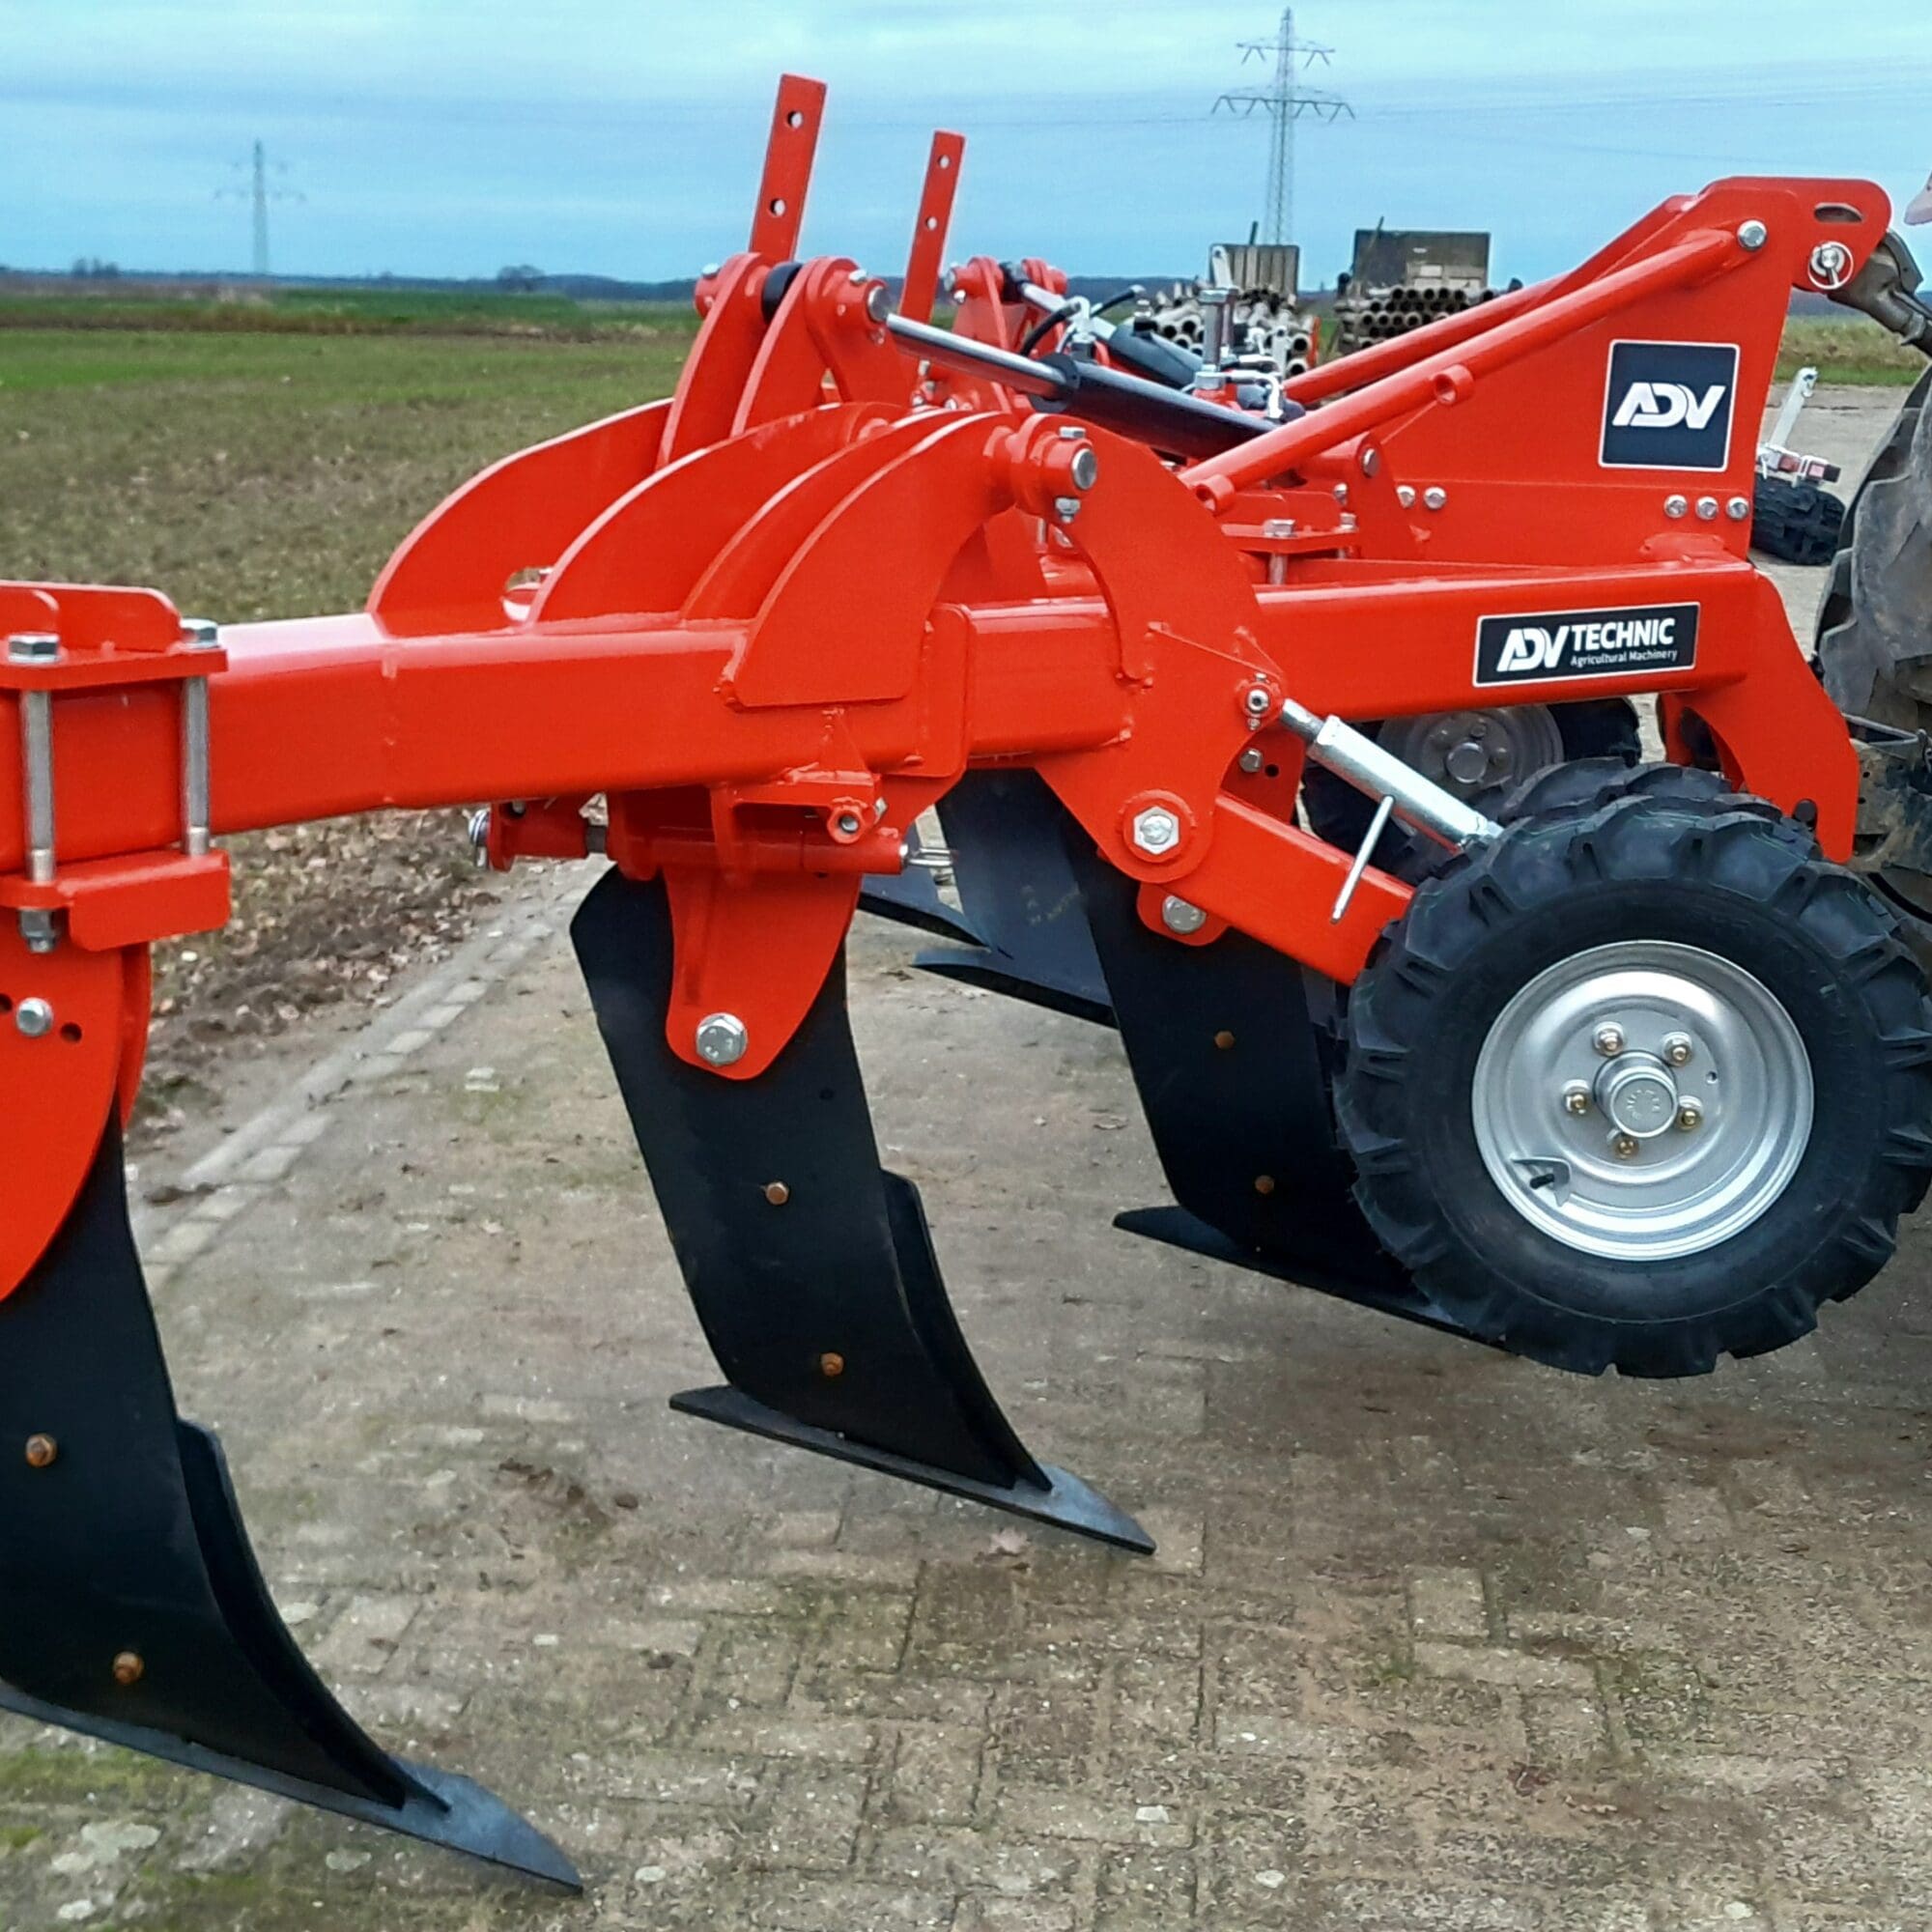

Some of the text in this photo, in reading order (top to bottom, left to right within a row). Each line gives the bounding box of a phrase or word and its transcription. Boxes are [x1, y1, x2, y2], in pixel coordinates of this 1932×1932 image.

[1612, 382, 1726, 429] ADV
[1496, 617, 1676, 671] ADV TECHNIC
[1571, 648, 1678, 668] Agricultural Machinery
